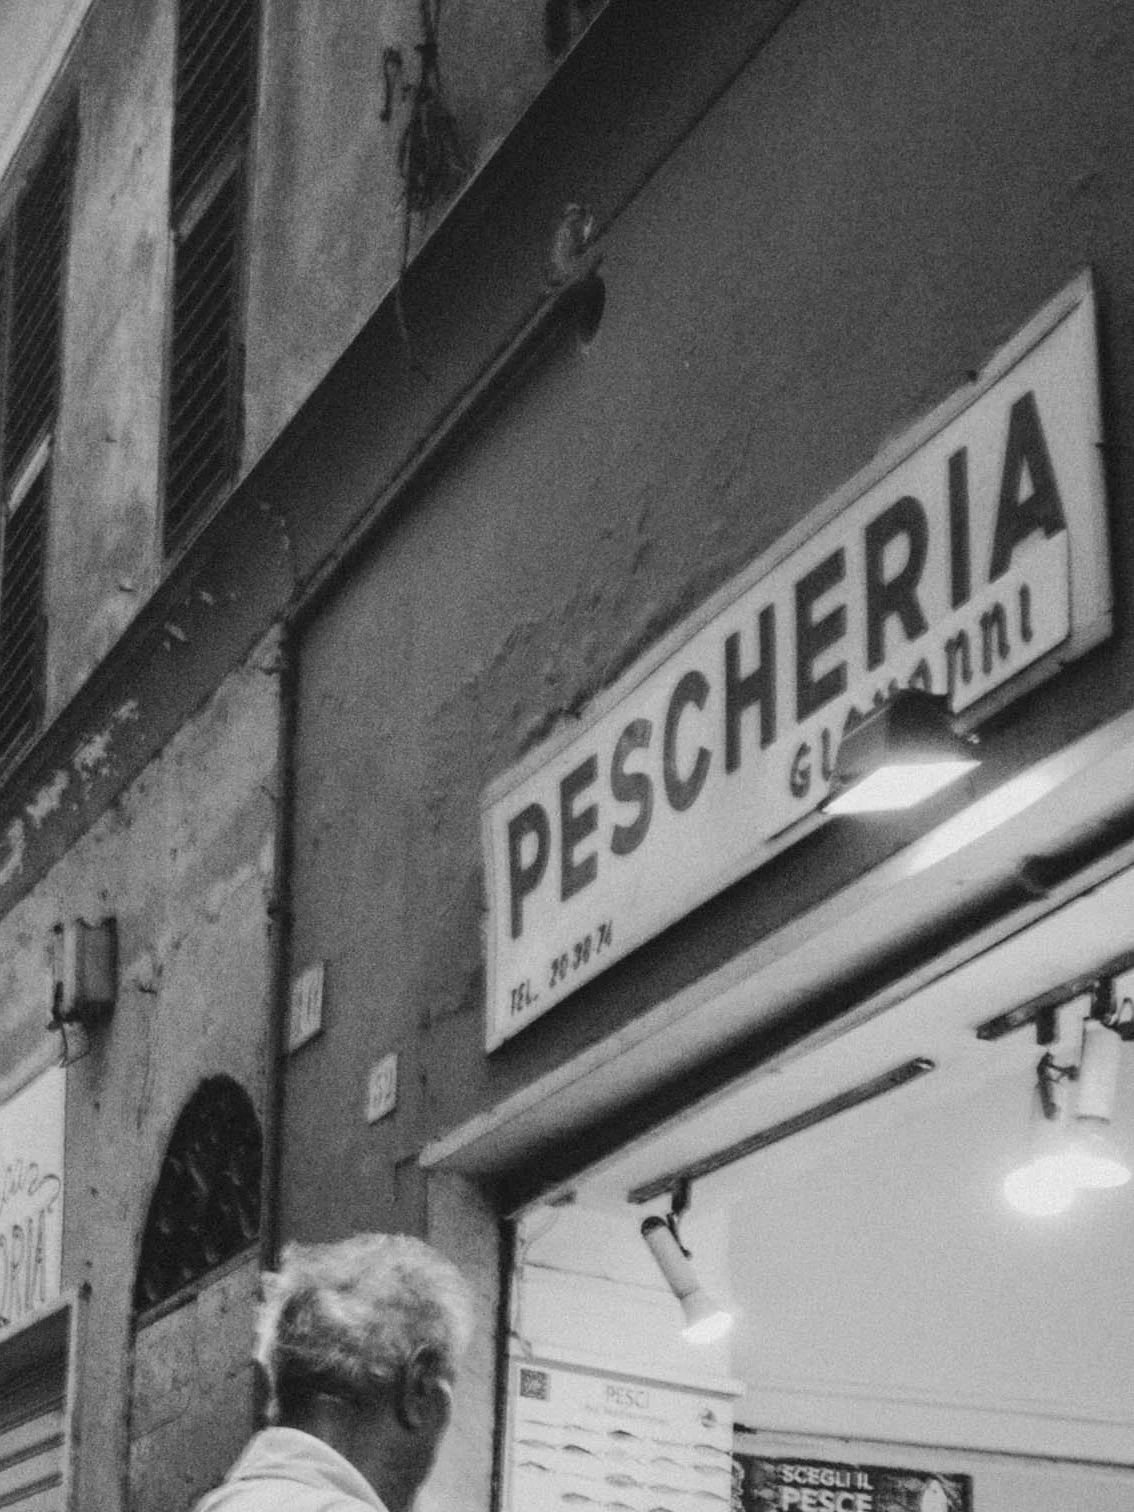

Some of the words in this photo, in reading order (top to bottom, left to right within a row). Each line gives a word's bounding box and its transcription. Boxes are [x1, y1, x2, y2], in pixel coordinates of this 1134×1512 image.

[507, 390, 1067, 940] PESCHERIA
[605, 1384, 650, 1409] PESCI
[780, 1463, 851, 1489] SCEGLI
[857, 1472, 873, 1490] IL
